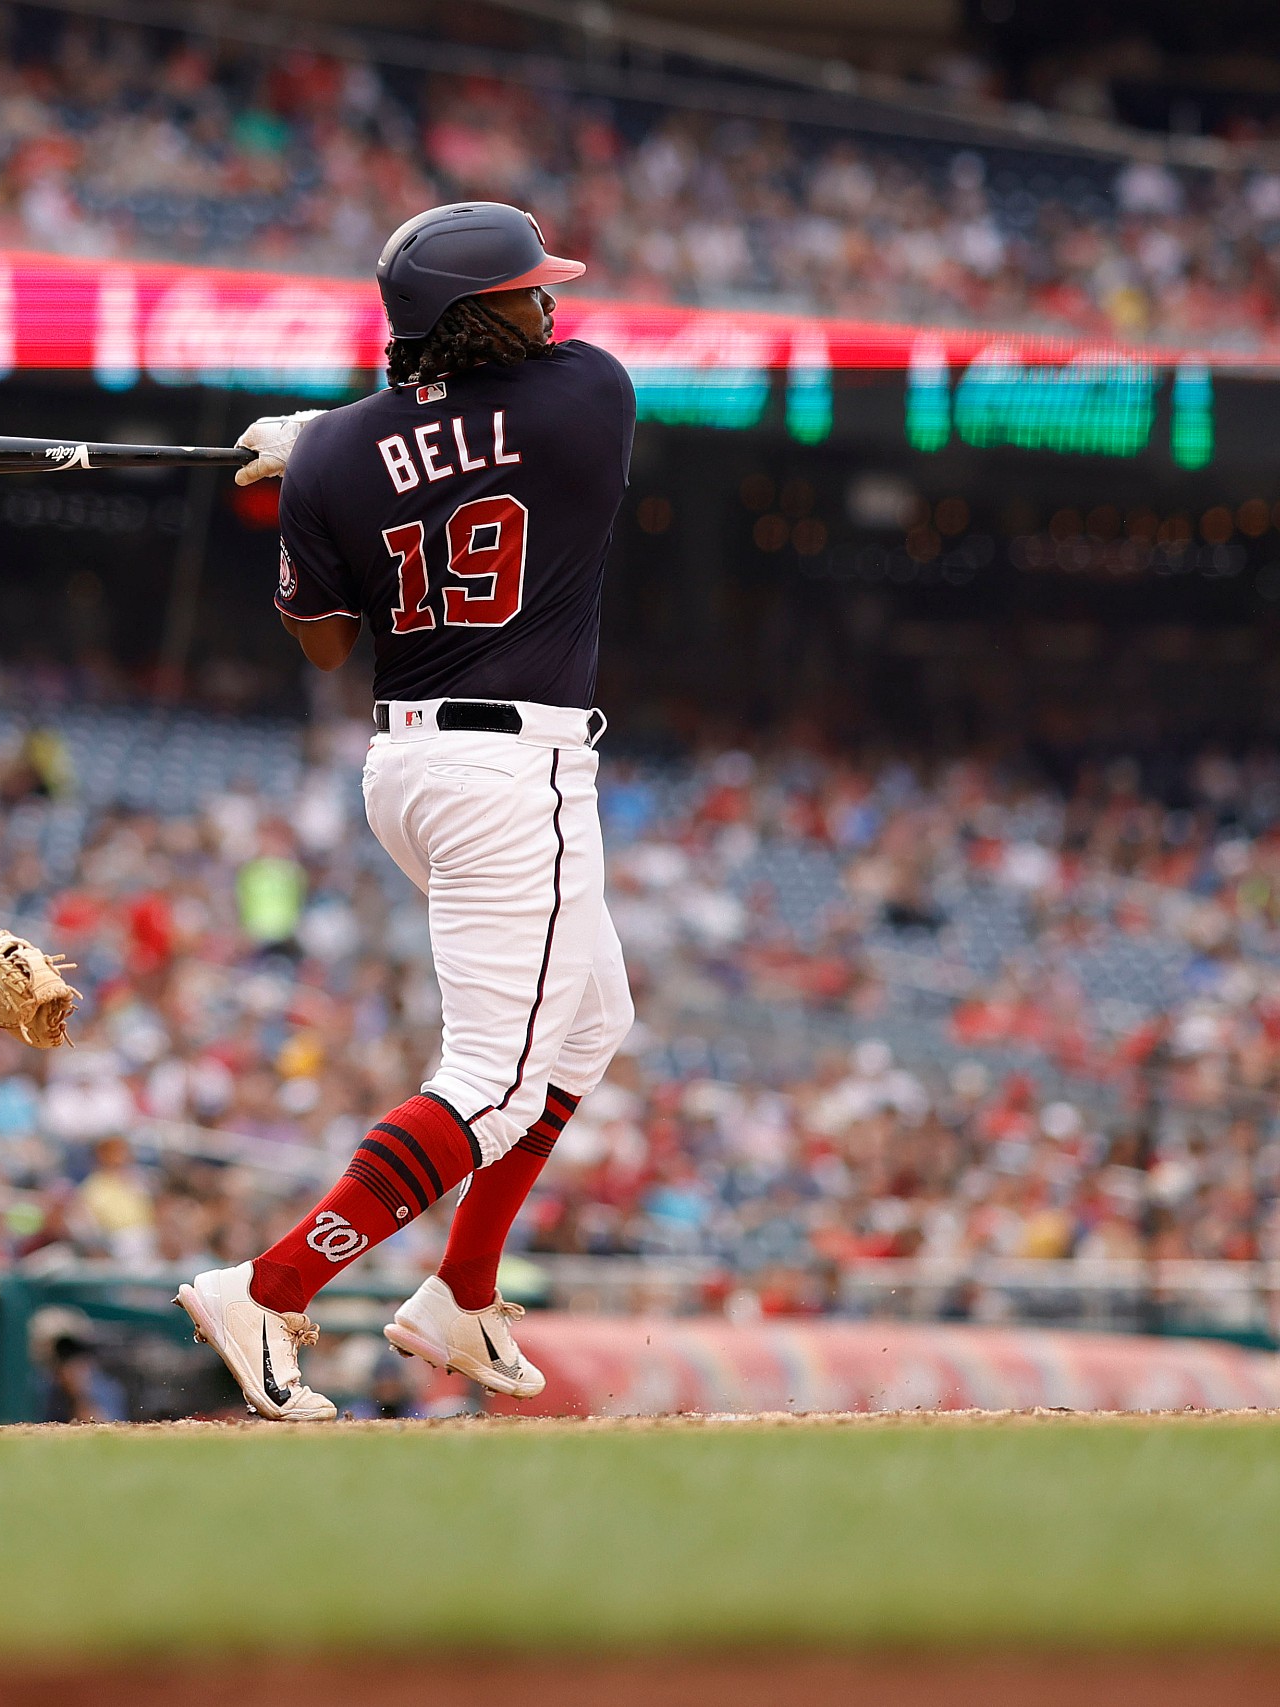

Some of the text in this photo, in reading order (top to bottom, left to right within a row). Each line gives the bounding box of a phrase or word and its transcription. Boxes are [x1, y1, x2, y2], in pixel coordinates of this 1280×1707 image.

[42, 444, 102, 472] Victus
[376, 409, 522, 495] BELL
[382, 494, 529, 634] 19
